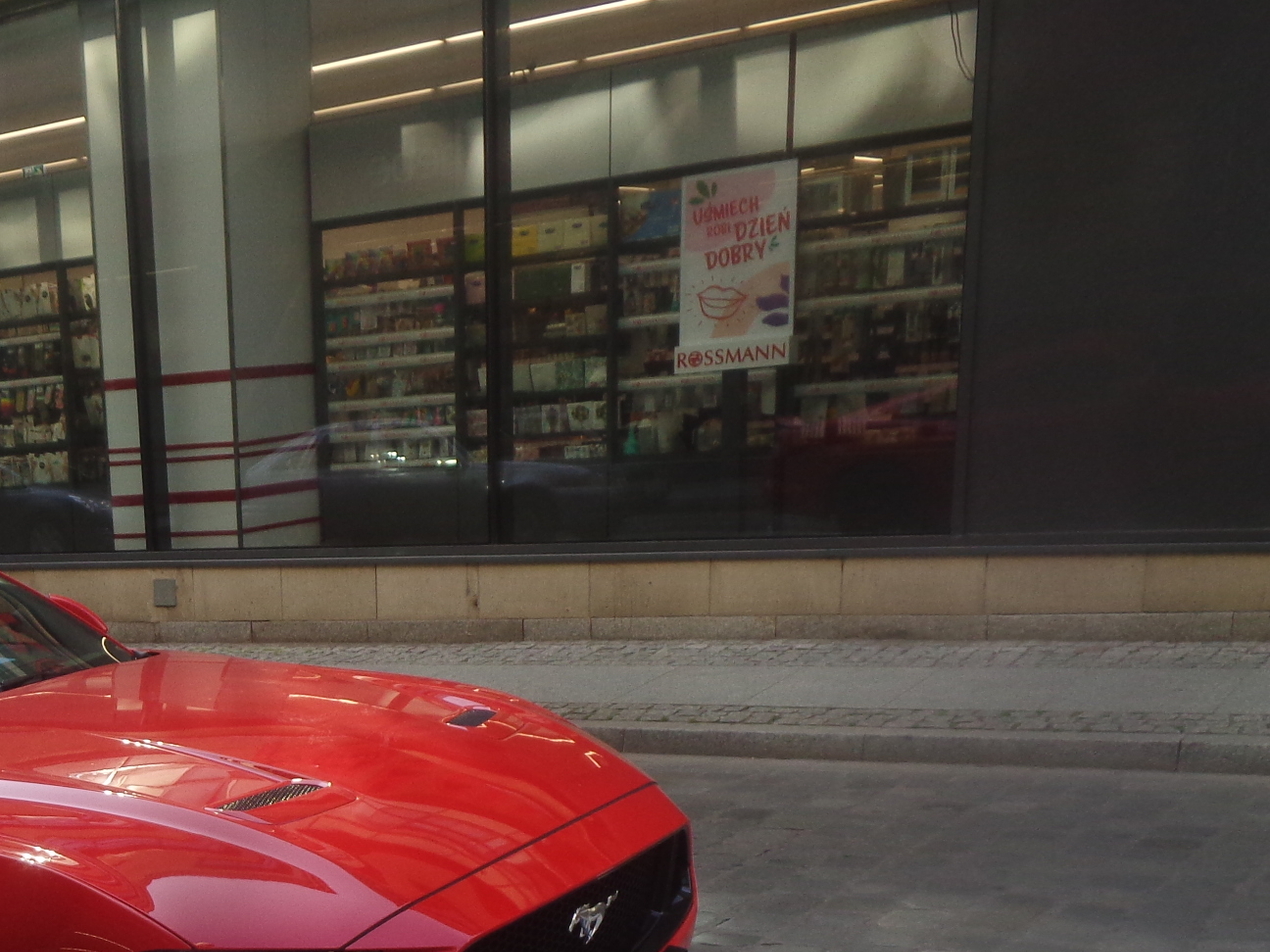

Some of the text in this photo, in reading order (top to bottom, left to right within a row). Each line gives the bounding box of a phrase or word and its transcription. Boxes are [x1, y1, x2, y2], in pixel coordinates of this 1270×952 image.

[734, 206, 791, 242] DZIEŃ
[705, 239, 767, 270] DOBRY
[676, 342, 787, 369] ROSSMANN
